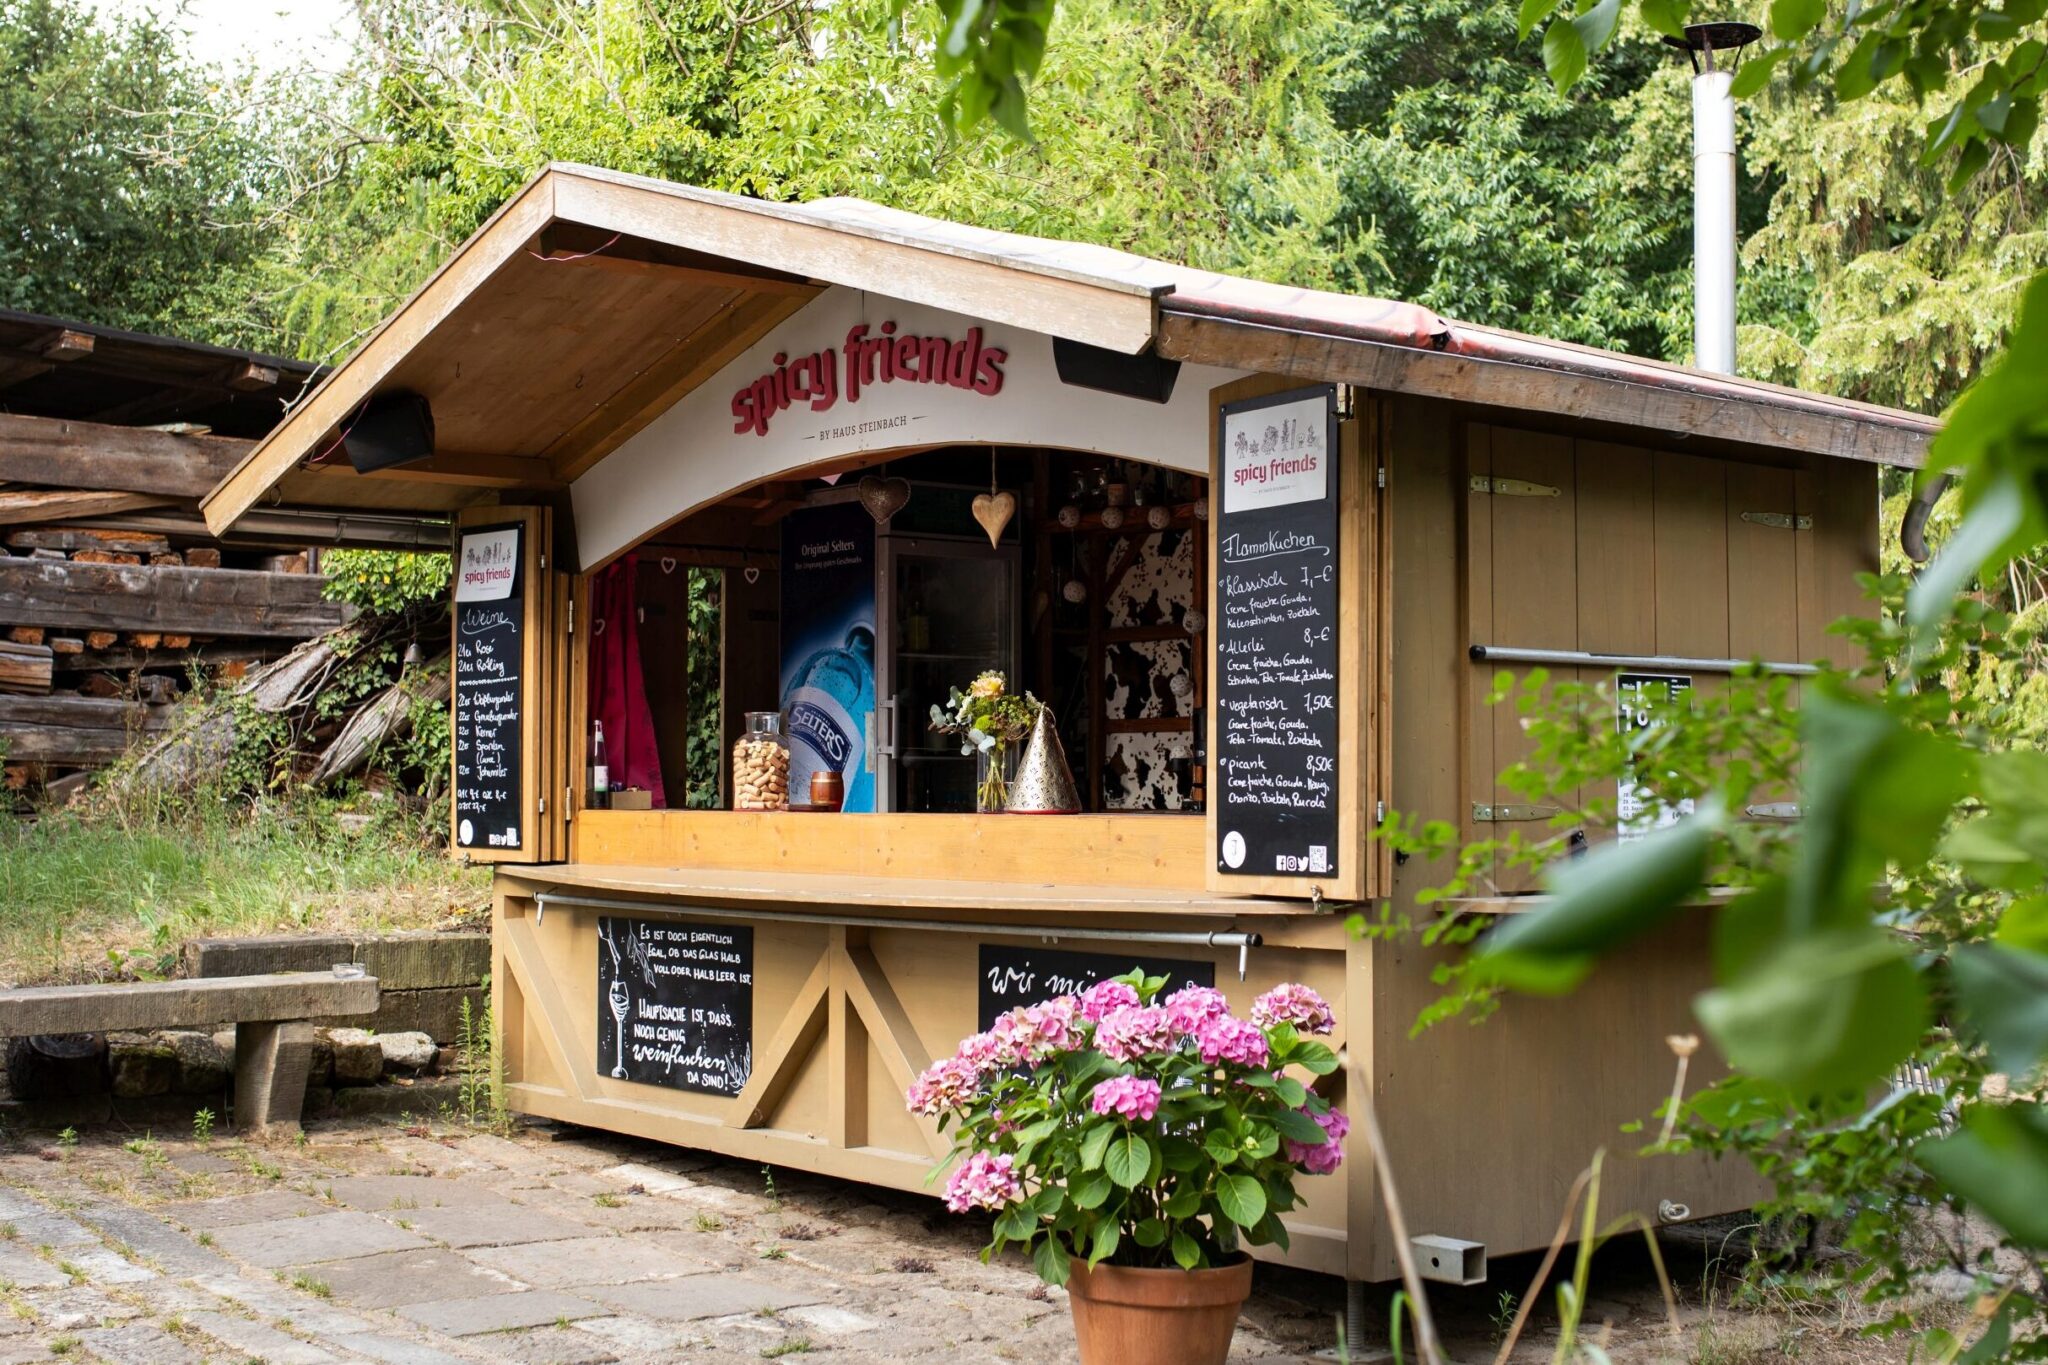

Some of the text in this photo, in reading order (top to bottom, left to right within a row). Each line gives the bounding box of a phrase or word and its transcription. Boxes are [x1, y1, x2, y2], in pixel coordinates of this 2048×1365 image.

[731, 320, 1008, 436] spicy friends
[819, 415, 907, 441] BY HAUS STEINBACH
[1234, 454, 1317, 486] spicy friends
[801, 539, 855, 557] Original Selters
[464, 567, 511, 585] spicy friends
[466, 608, 509, 626] Weine
[475, 638, 496, 655] Rosé
[1226, 637, 1265, 655] Allerlei
[788, 706, 845, 761] SELTERS
[654, 930, 666, 940] IST
[667, 930, 688, 941] DOCH
[690, 932, 733, 945] EIGENTLICH
[668, 947, 680, 958] OB
[683, 949, 697, 959] DAS
[698, 949, 718, 961] GLAS
[720, 951, 741, 964] HALB
[653, 963, 670, 974] VOLL
[671, 965, 692, 976] ODER
[693, 968, 715, 981] HALB
[715, 970, 737, 983] LEER
[638, 998, 732, 1027] HAUPTSACHE IST, DASS
[634, 1023, 686, 1045] NOCH GENUG
[686, 1071, 729, 1091] DA SIND!
